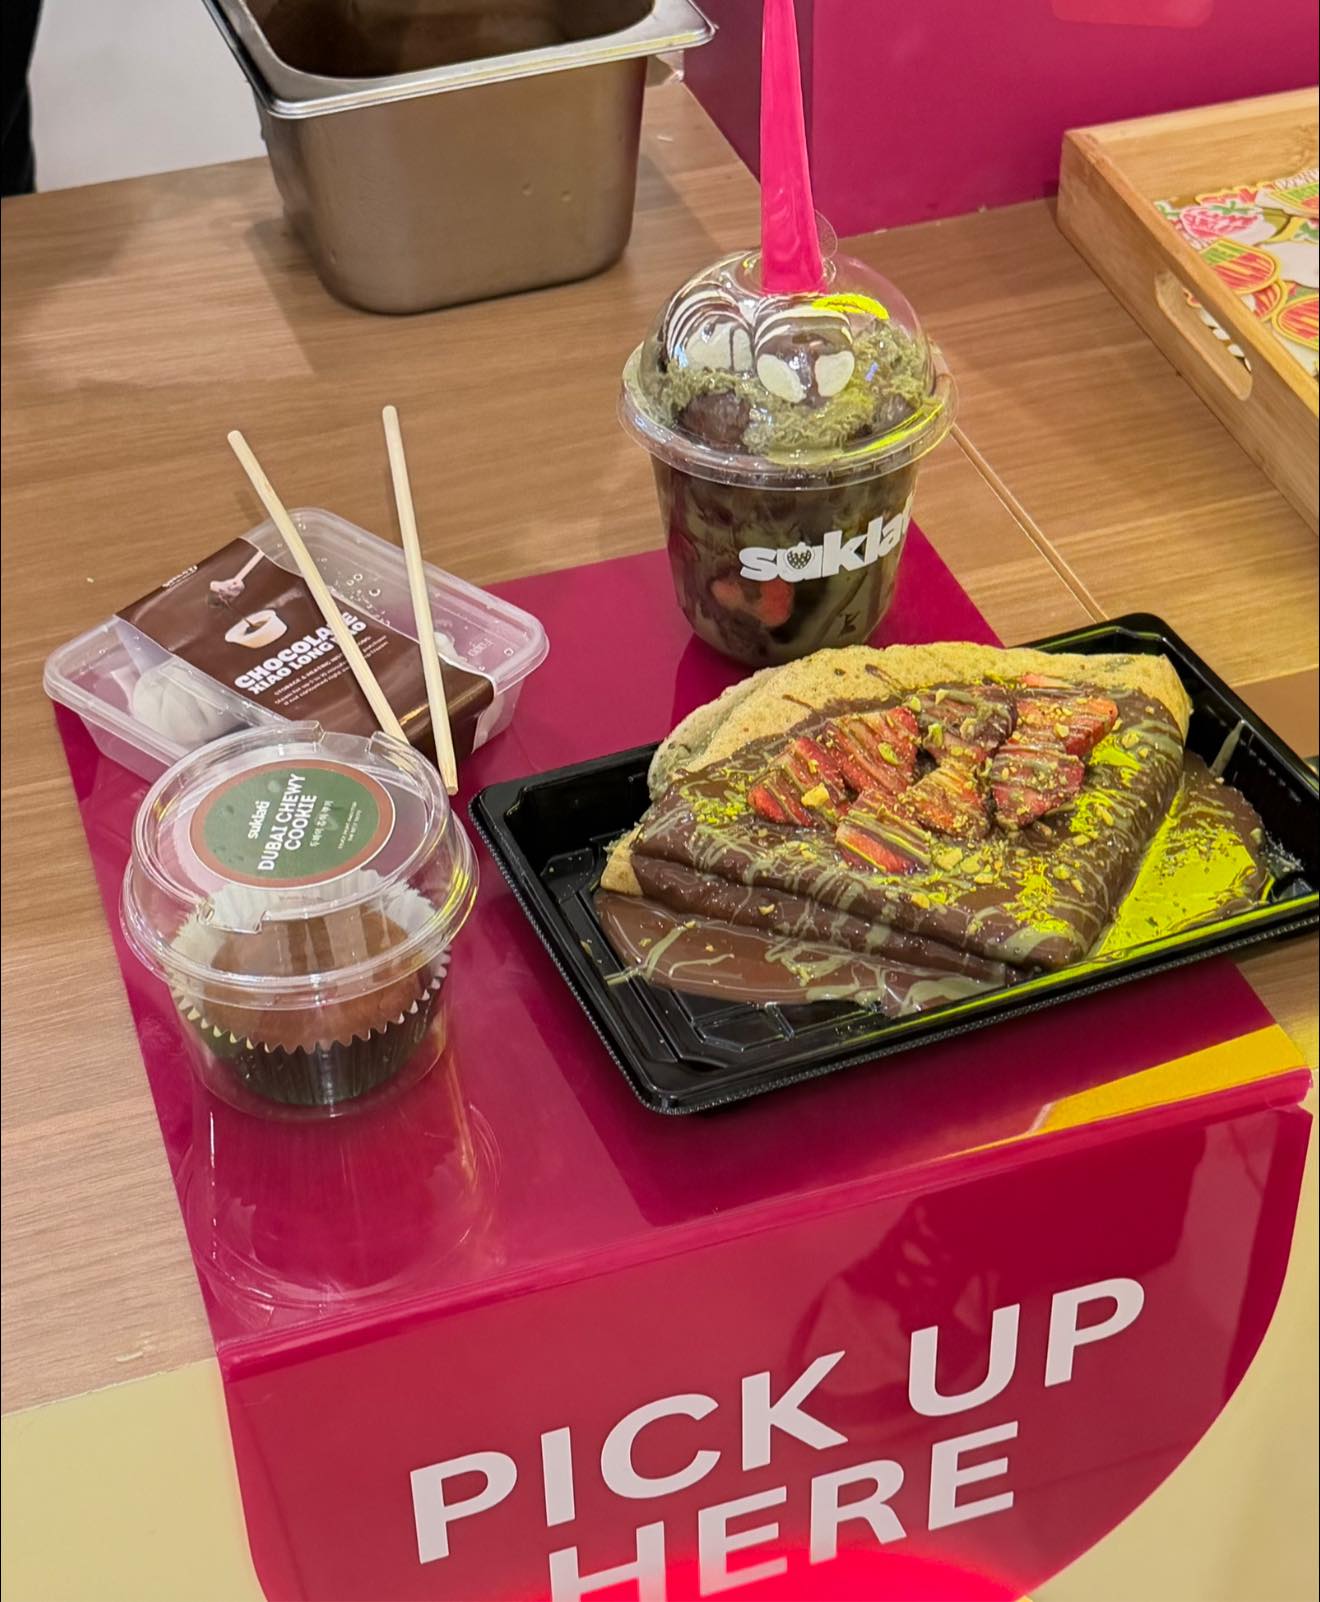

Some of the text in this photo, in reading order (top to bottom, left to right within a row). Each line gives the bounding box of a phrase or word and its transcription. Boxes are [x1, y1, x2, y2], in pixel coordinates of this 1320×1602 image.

[234, 611, 358, 688] CHOCOLAE
[248, 667, 292, 694] XIAO
[288, 641, 334, 670] LONG
[247, 800, 271, 839] suklati
[257, 773, 306, 870] DUBAI CHEWY
[284, 794, 317, 851] COOKIE
[409, 1276, 1146, 1564] PICK UP
[548, 1421, 1019, 1602] HERE
